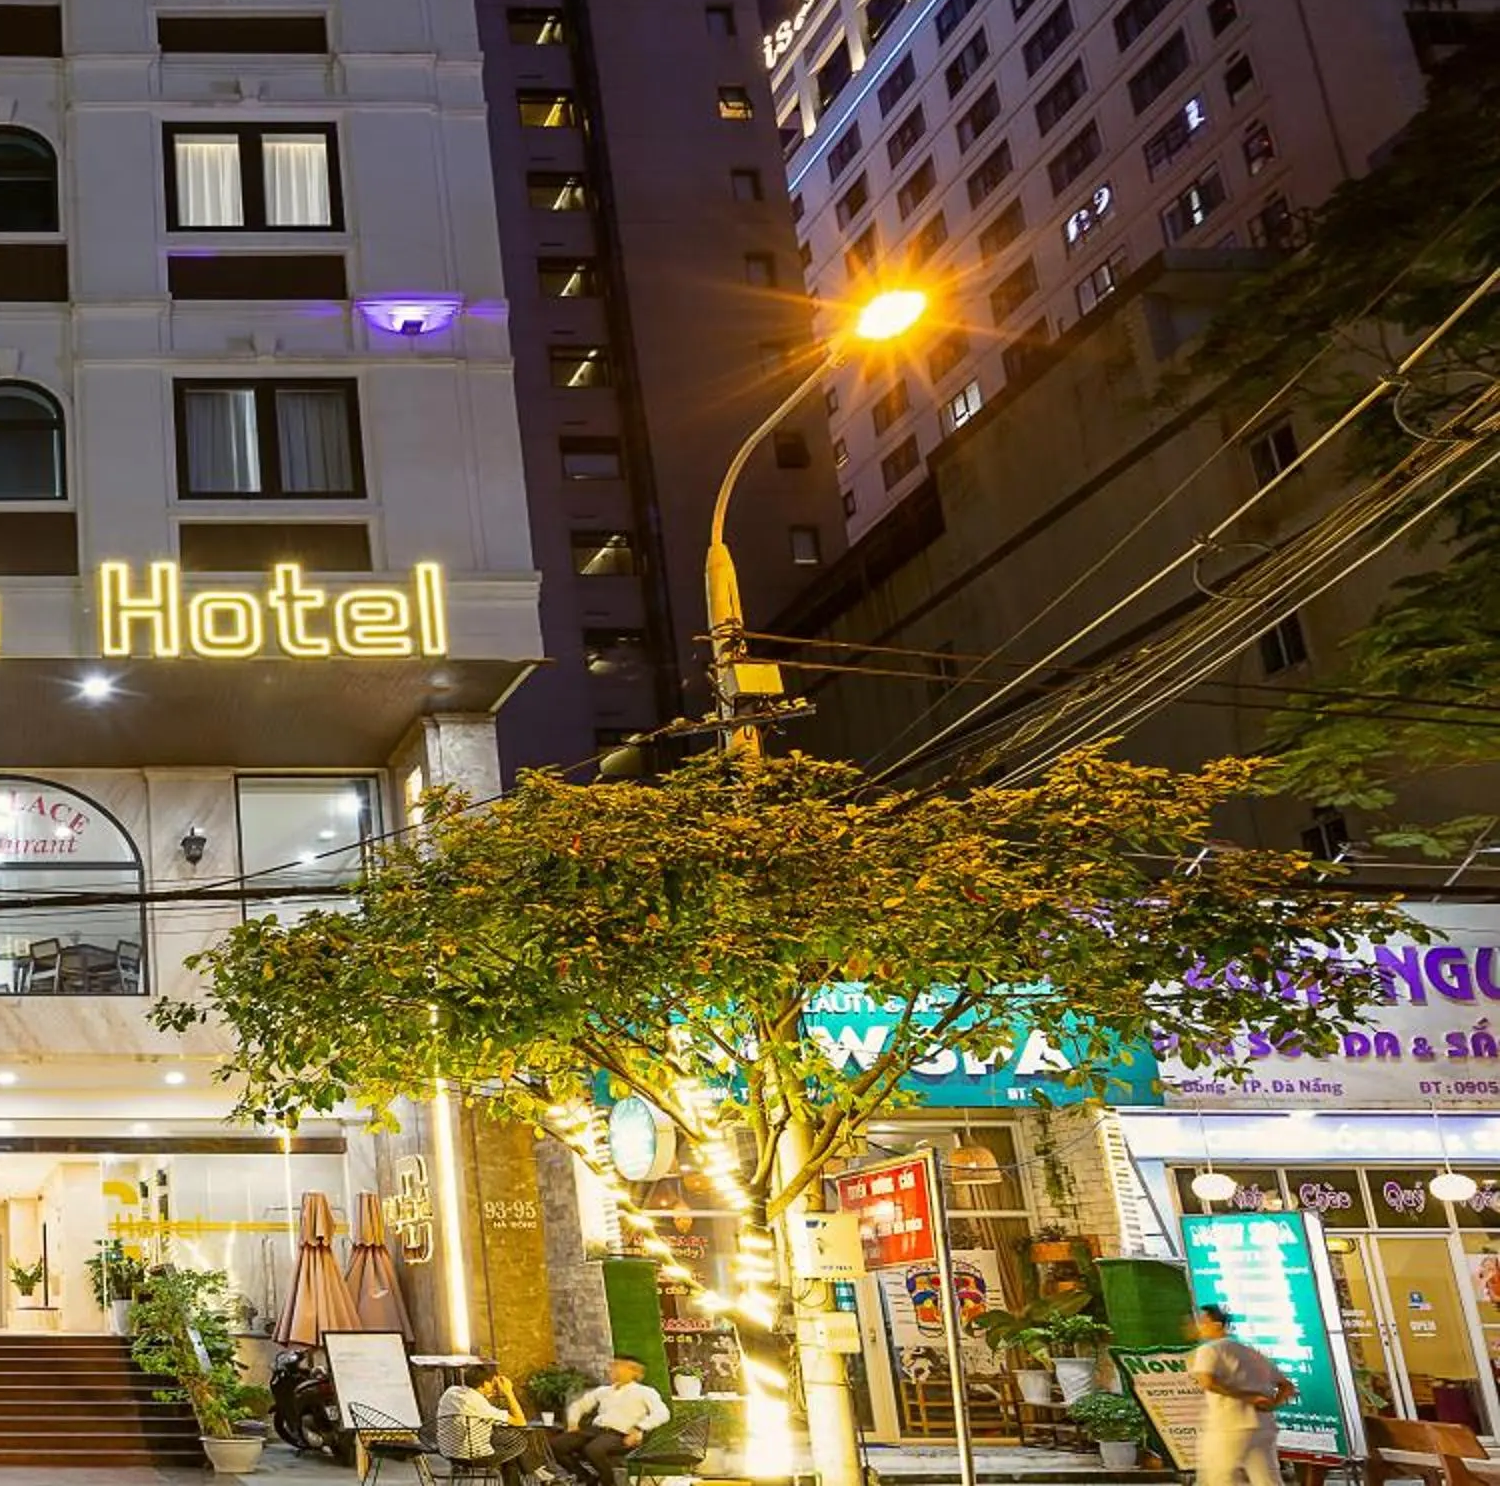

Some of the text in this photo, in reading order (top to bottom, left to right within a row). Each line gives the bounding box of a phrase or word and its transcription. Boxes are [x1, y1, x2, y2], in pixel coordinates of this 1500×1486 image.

[97, 560, 449, 659] Hotel
[1343, 1032, 1401, 1058] DA
[484, 1201, 537, 1218] 93-95
